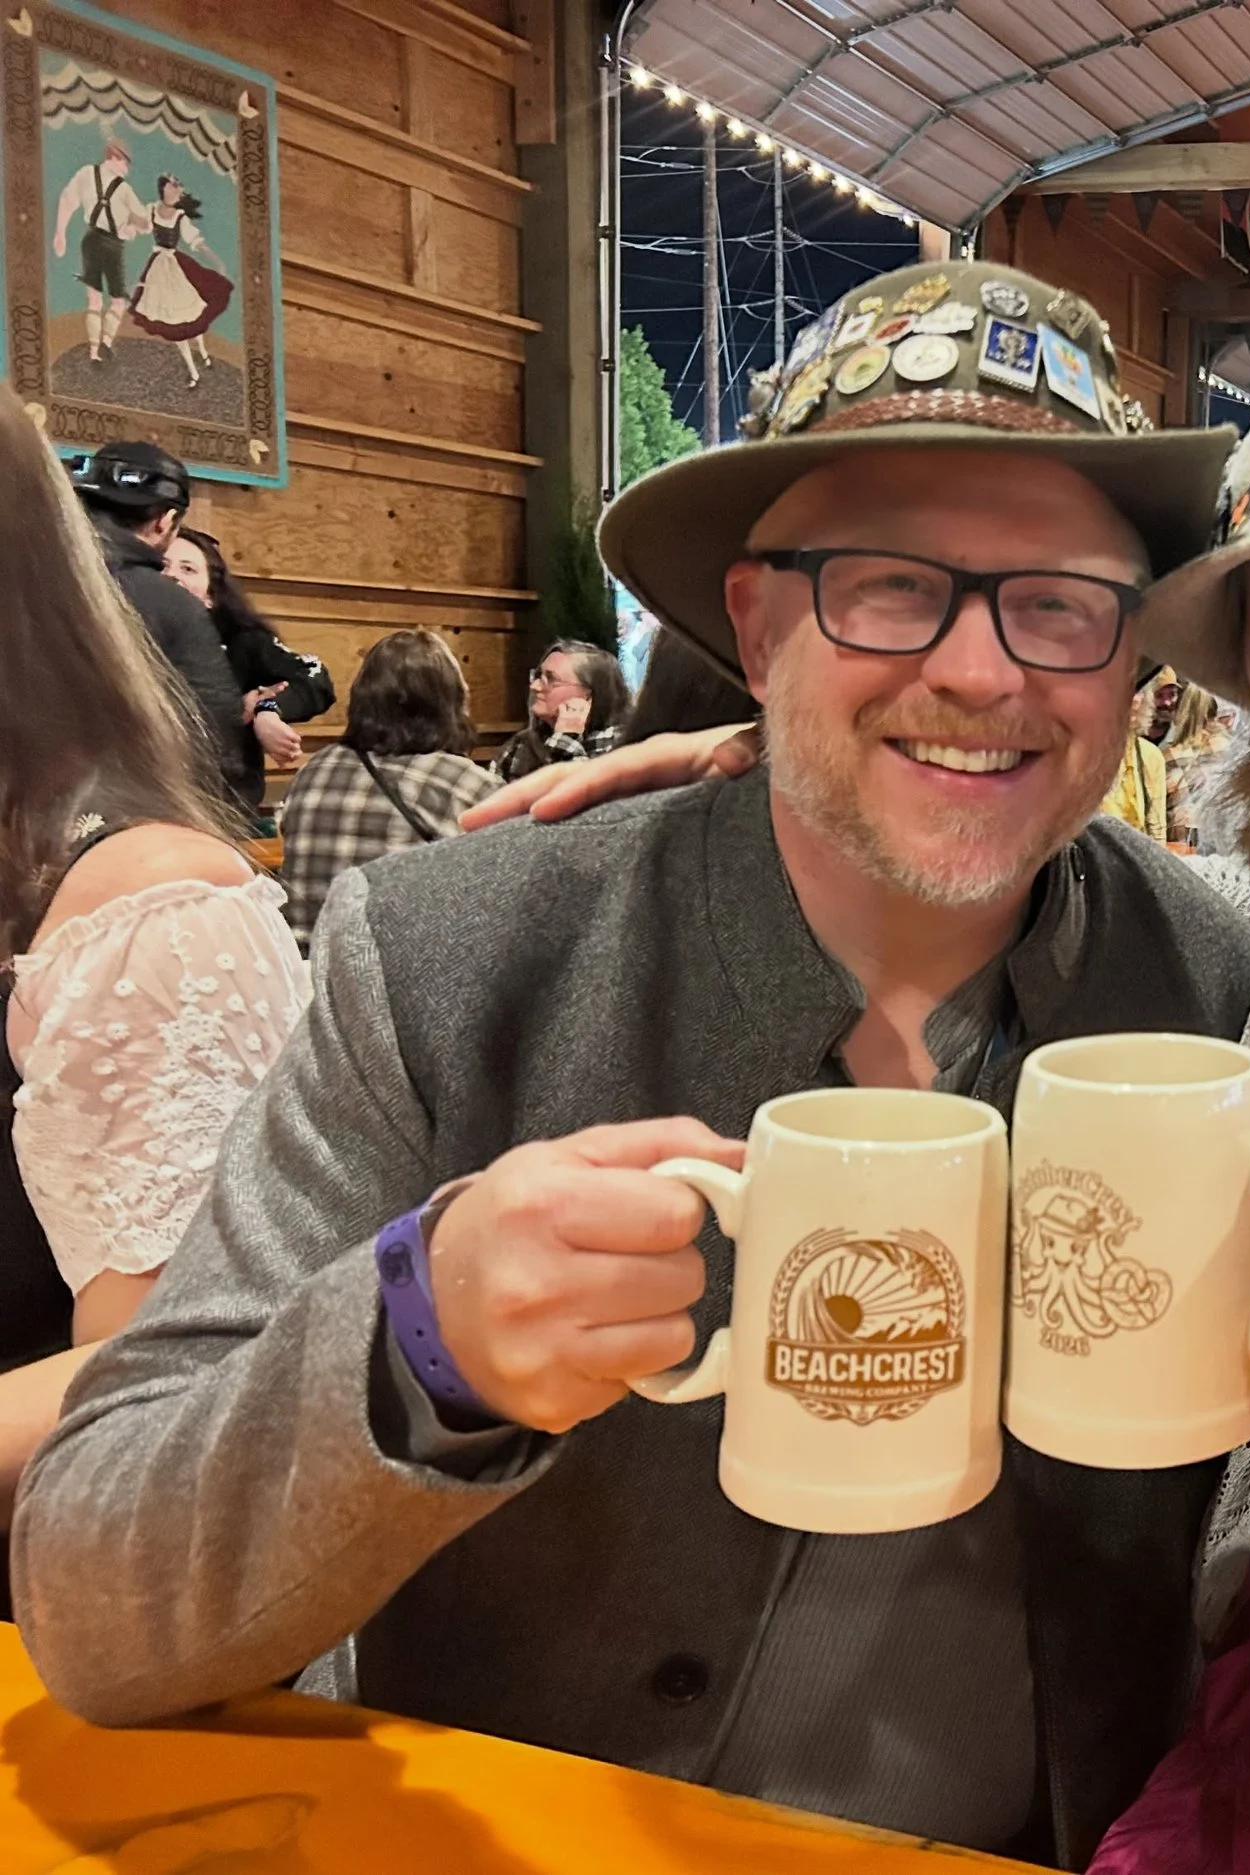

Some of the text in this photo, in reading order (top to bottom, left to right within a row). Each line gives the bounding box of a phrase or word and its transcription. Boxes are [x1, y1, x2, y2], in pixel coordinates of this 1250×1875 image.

[774, 1343, 961, 1383] BEACHCREST
[804, 1381, 928, 1398] BREWING COMPANY
